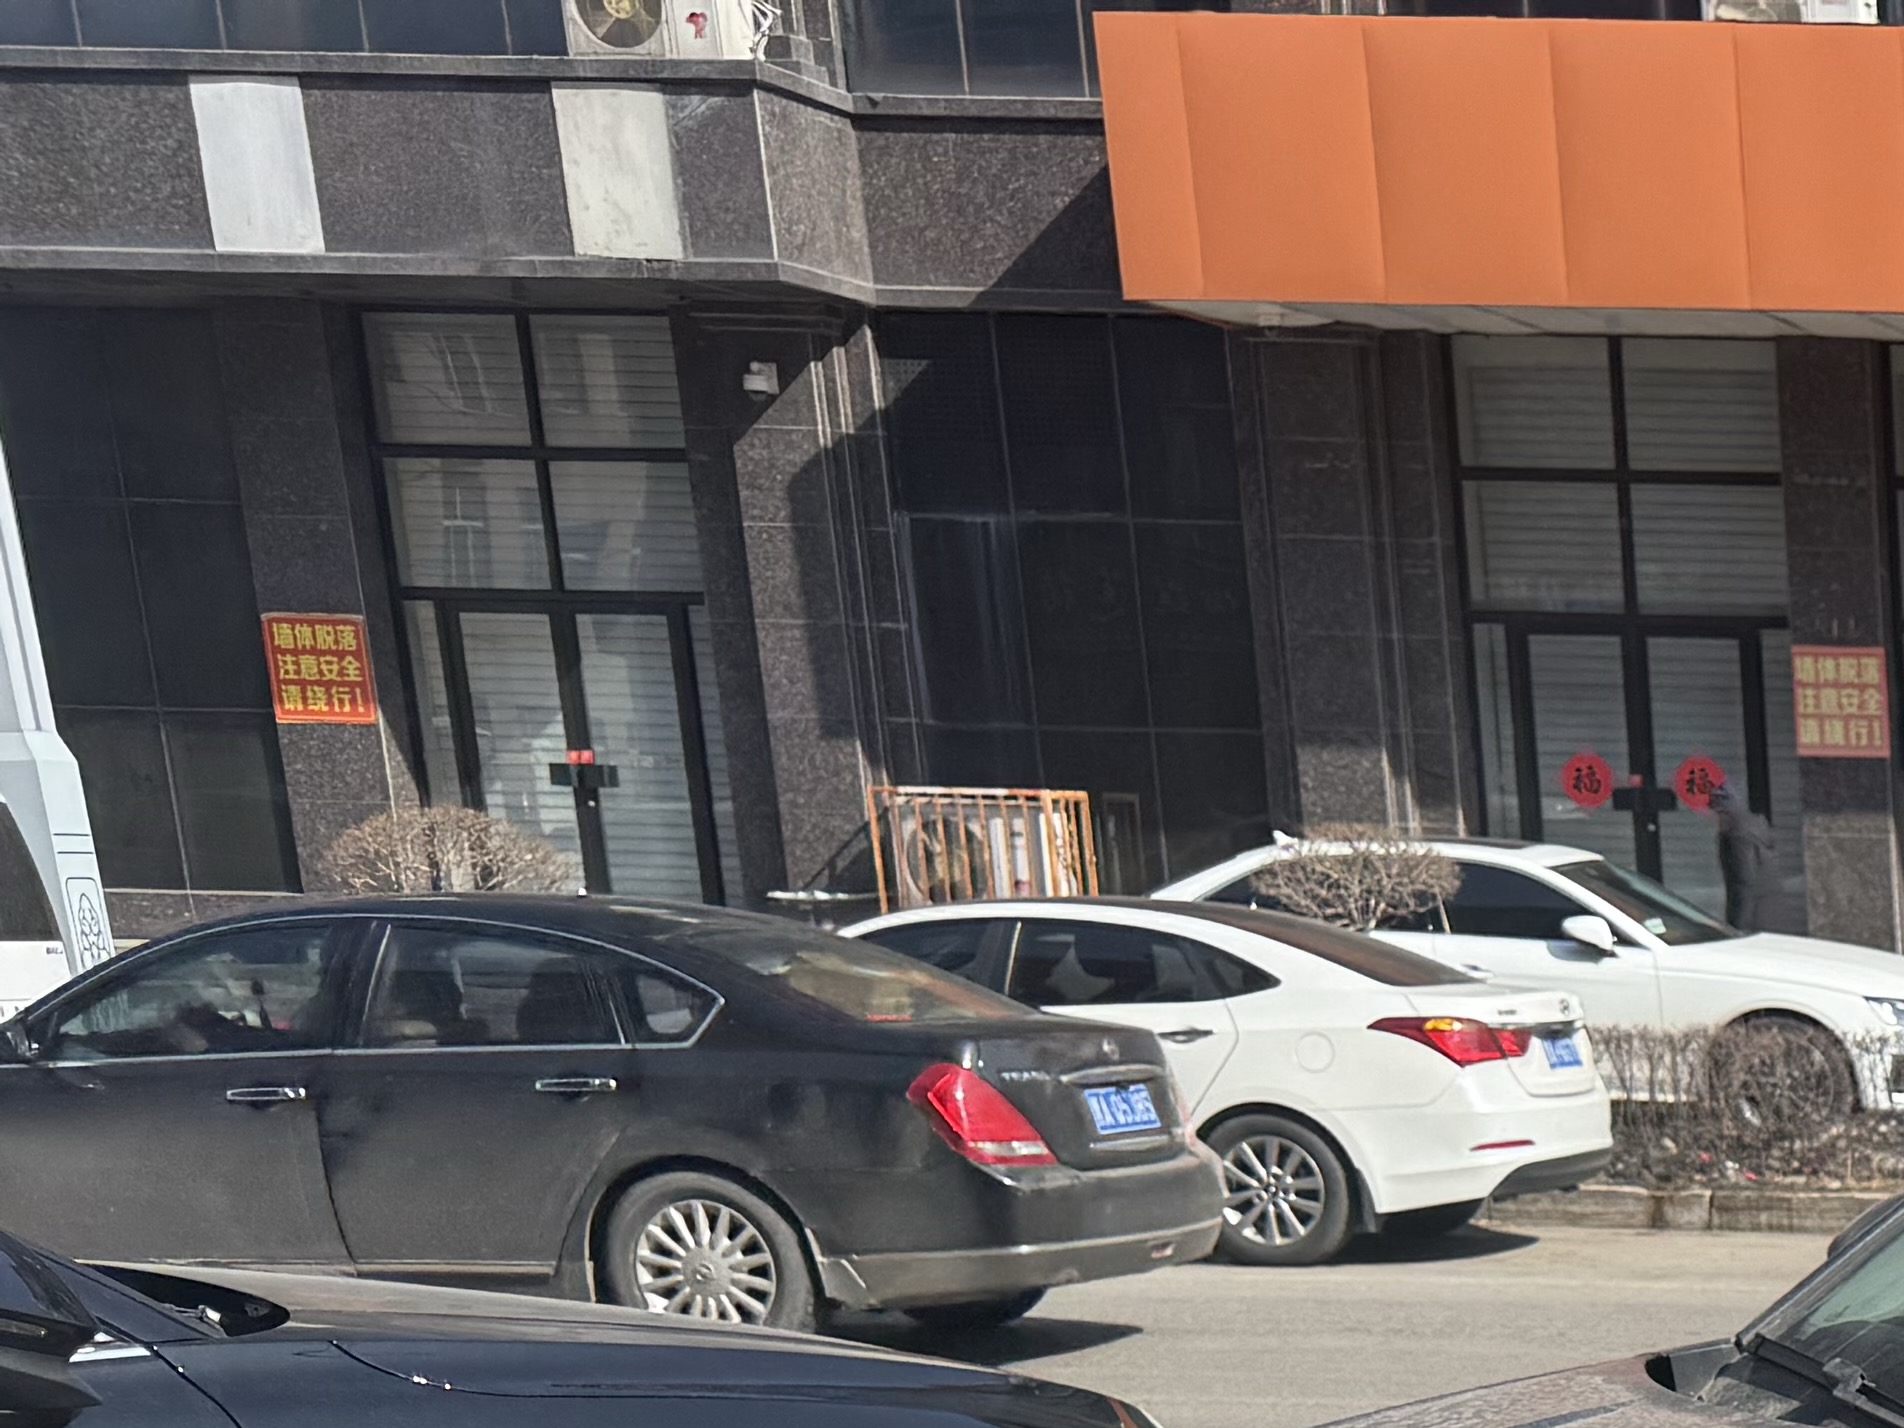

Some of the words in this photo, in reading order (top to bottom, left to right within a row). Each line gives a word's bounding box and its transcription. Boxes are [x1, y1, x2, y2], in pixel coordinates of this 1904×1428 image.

[272, 623, 357, 651] 墙体脱落
[277, 653, 363, 681] 注意安全
